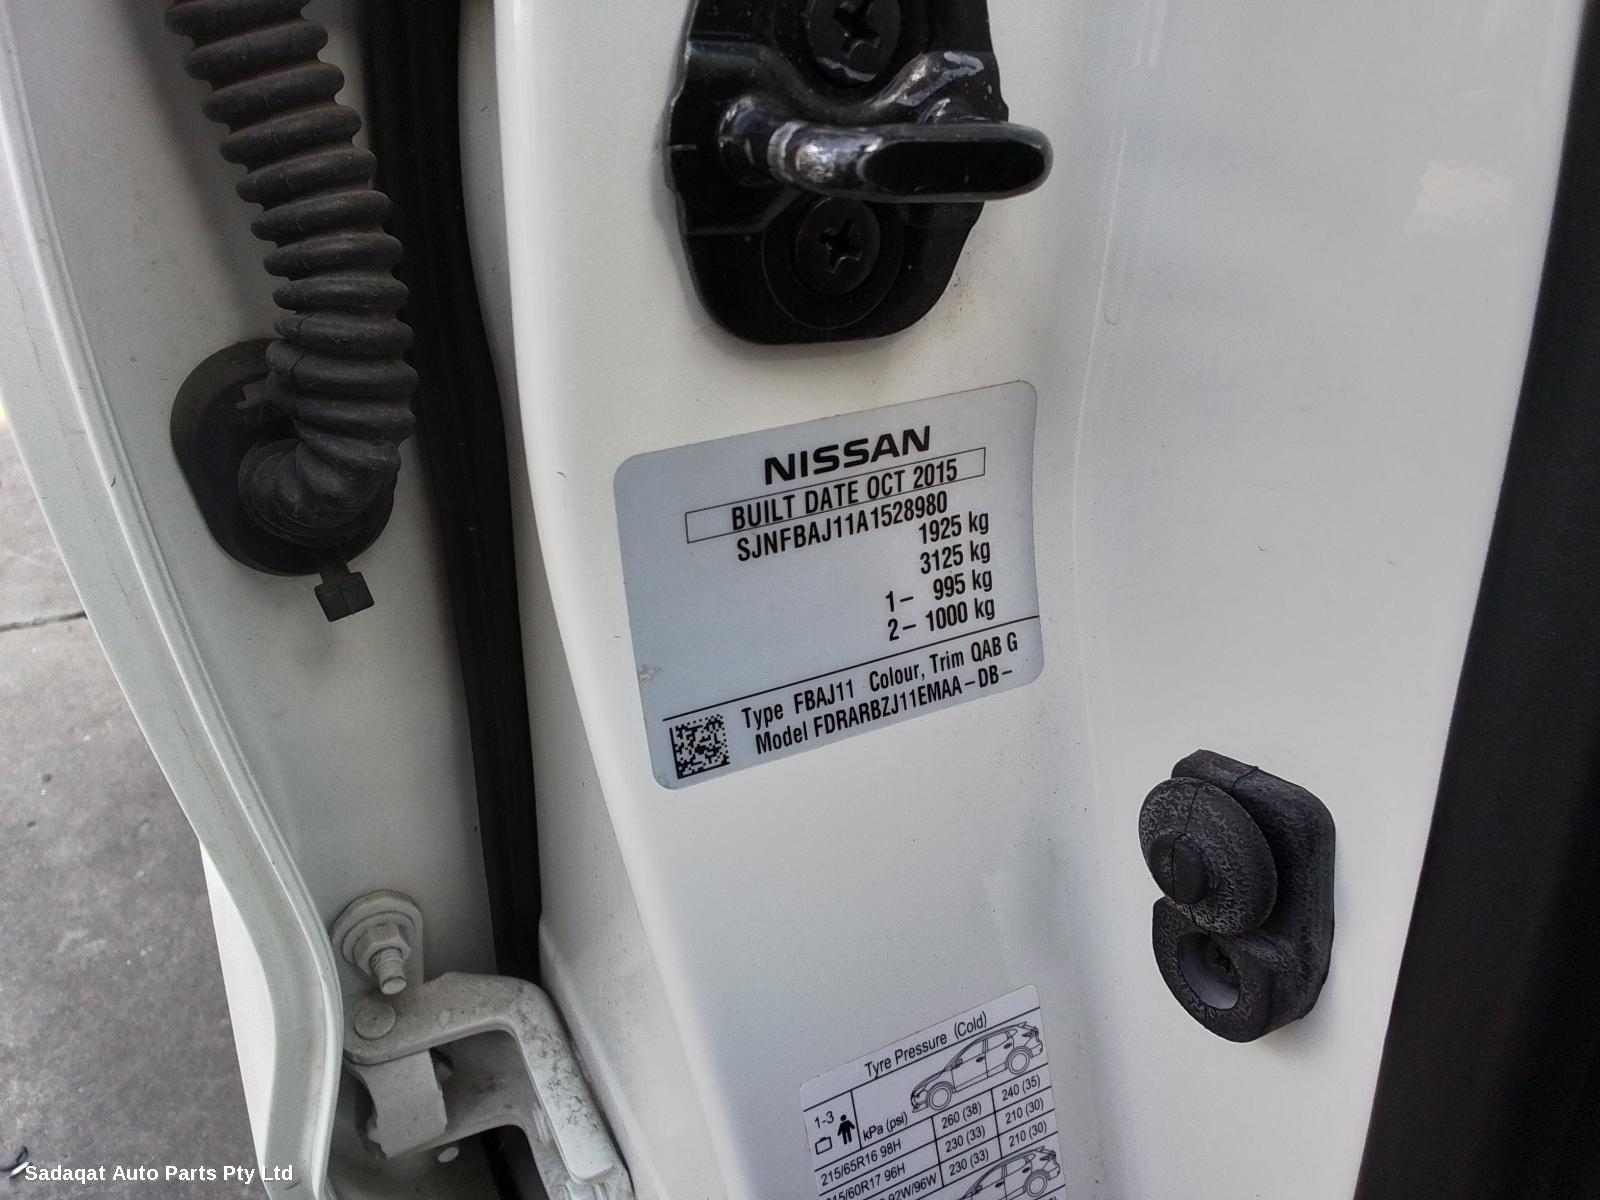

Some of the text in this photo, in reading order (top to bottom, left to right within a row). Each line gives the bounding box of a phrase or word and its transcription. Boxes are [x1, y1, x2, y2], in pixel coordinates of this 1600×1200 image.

[765, 425, 930, 484] NISSAN
[732, 459, 957, 530] BUILT DATE OCT 2015
[737, 491, 947, 560] SJNFBAJ11A1528980
[919, 510, 989, 544] 1925 kg
[920, 539, 991, 574] 3125 kg
[933, 572, 966, 601] 995
[972, 568, 993, 592] kg
[925, 601, 967, 633] 1000
[974, 597, 996, 619] kg
[741, 631, 1019, 730] Type FBAJ11 Colour, Trim QAB G
[755, 721, 809, 754] Model
[864, 1011, 987, 1079] Tyre Pressure (Cold)
[1002, 1074, 1041, 1100] 240 (35)
[814, 1110, 834, 1129] 1-3
[862, 1112, 908, 1141] kPa (psi)
[941, 1102, 982, 1129] 260 (38)
[1005, 1097, 1043, 1124] 210 (30)
[945, 1125, 985, 1152] 230 (33)
[1008, 1120, 1047, 1147] 210 (30)
[820, 1139, 902, 1186] 215/65R16 98H
[949, 1149, 989, 1176] 230 (33)
[826, 1165, 906, 1200] 15/60R17 96H
